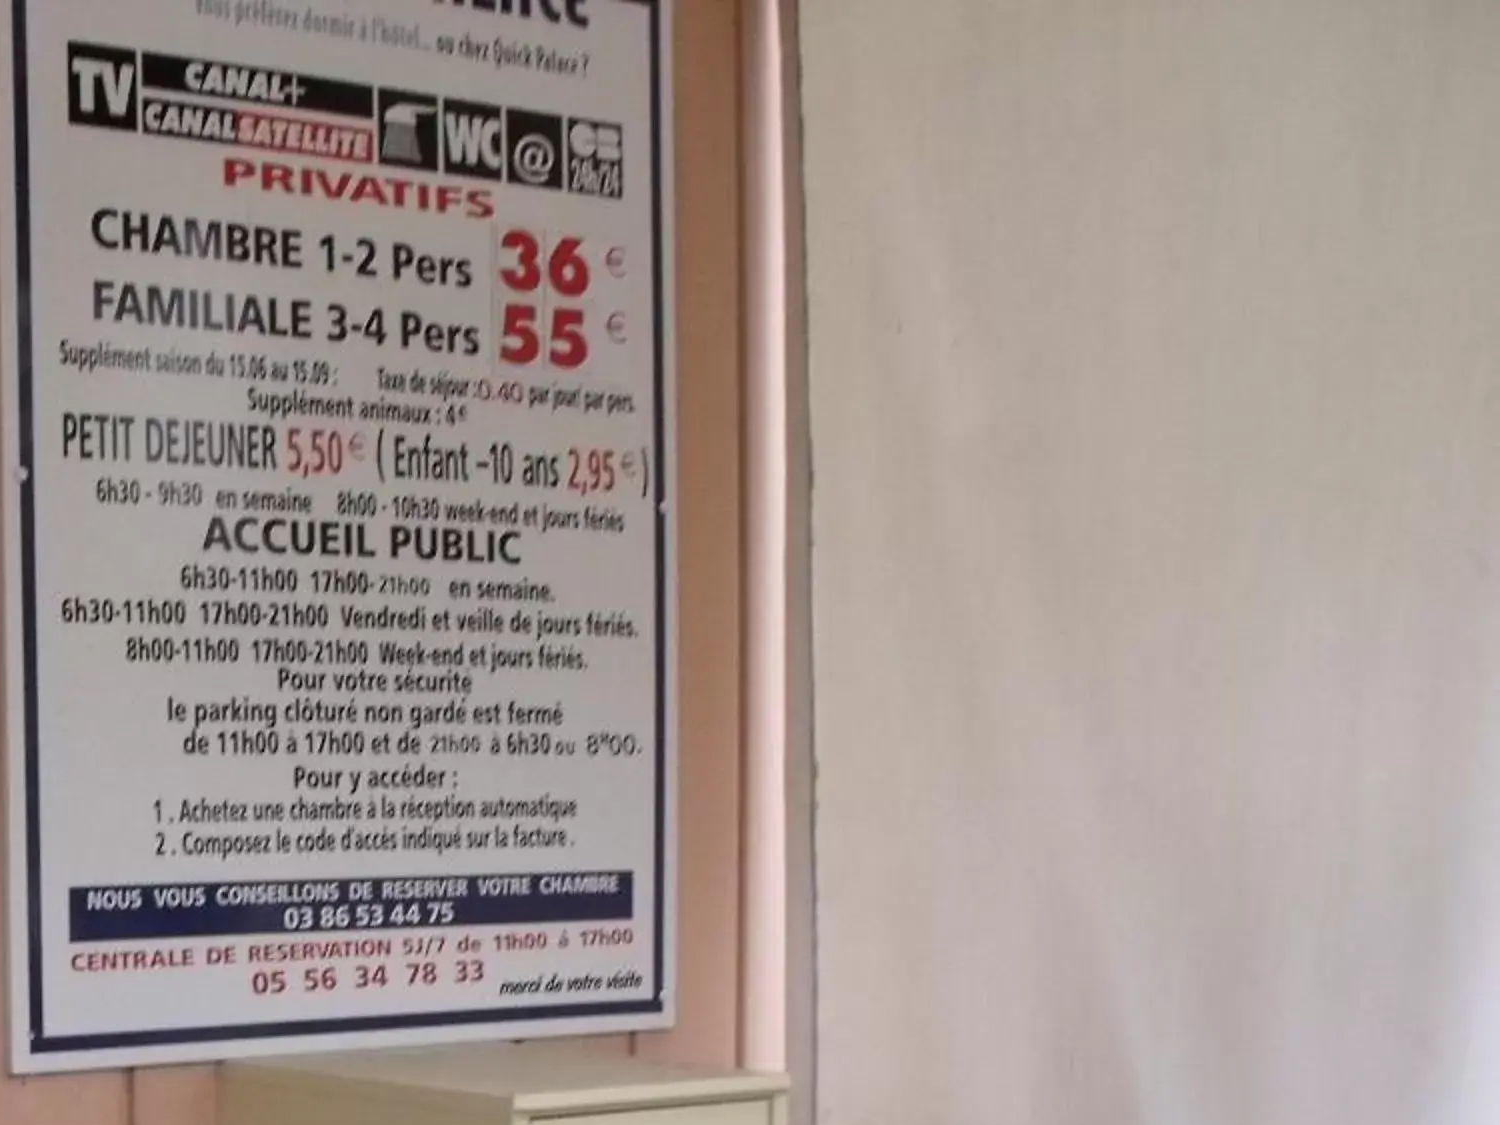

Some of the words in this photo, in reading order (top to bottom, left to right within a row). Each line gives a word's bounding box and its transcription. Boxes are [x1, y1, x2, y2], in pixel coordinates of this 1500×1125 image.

[436, 34, 455, 55] ou
[459, 30, 490, 63] chez
[493, 35, 531, 71] Quick
[534, 43, 578, 76] Palace
[71, 56, 135, 118] TV
[184, 61, 308, 106] CANAL+
[445, 112, 502, 171] WC
[223, 157, 495, 219] PRIVATIFS
[91, 208, 303, 269] CHAMBRE
[319, 233, 378, 279] 1-2
[392, 242, 473, 288] Pers
[499, 228, 591, 298] 36
[92, 279, 313, 340] FAMILIALE
[326, 302, 388, 347] 3-4
[401, 310, 480, 356] Pers
[499, 302, 589, 371] 55
[59, 338, 151, 374] Supplément
[155, 347, 202, 376] saison
[205, 351, 225, 377] du
[271, 360, 289, 383] au
[246, 387, 354, 419] Supplément
[359, 398, 431, 425] animaux
[377, 367, 406, 394] Taxe
[409, 370, 426, 395] de
[528, 384, 550, 408] par
[584, 391, 605, 415] par
[61, 411, 136, 464] PETIT
[145, 416, 279, 471] DEJEUNER
[393, 433, 470, 483] Enfant
[522, 451, 560, 488] ans
[96, 478, 141, 505] 6h30
[158, 480, 204, 508] 9h30
[215, 490, 238, 511] en
[242, 486, 313, 515] semaine
[336, 488, 377, 518] 8h00
[392, 494, 439, 522] 10h30
[445, 498, 519, 527] week-end
[522, 507, 538, 528] et
[541, 504, 579, 534] jours
[202, 516, 377, 559] ACCUEIL
[390, 524, 522, 566] PUBLIC
[180, 564, 298, 593] 6h30-11h00
[449, 580, 471, 600] en
[60, 598, 187, 626] 6h30-11h00
[198, 601, 329, 629] 17h00-21h00
[340, 605, 427, 632] Vendredi
[431, 609, 451, 632] et
[456, 606, 504, 635] veille
[509, 609, 532, 634] de
[535, 610, 581, 641] jours
[125, 636, 240, 664] 8h00-11h00
[250, 638, 369, 667] 17h00-21h00
[378, 640, 464, 668] Week-end
[468, 646, 487, 668] et
[489, 645, 534, 674] jours
[277, 667, 327, 693] Pour
[332, 671, 388, 693] votre
[166, 695, 188, 723] le
[194, 695, 278, 729] parking
[284, 697, 358, 724] clôturé
[364, 703, 404, 724] non
[409, 697, 467, 730] gardé
[472, 703, 502, 726] est
[507, 699, 564, 727] fermé
[183, 729, 210, 756] de
[217, 730, 279, 756] 11h00
[285, 730, 298, 756] à
[304, 730, 365, 756] 17h00
[371, 731, 391, 756] et
[396, 730, 421, 756] de
[429, 734, 482, 756] 21h00
[490, 734, 501, 756] à
[506, 731, 551, 757] 6h30
[293, 765, 343, 790] Pour
[348, 769, 362, 795] y
[367, 762, 447, 790] accéder
[179, 797, 248, 824] Achetez
[252, 802, 285, 823] une
[289, 796, 362, 822] chambre
[366, 798, 377, 821] à
[380, 795, 396, 821] la
[400, 794, 476, 823] réception
[478, 792, 578, 823] automatique
[181, 830, 272, 862] Composez
[275, 826, 291, 854] le
[296, 826, 336, 853] code
[401, 825, 462, 856] indiqué
[465, 829, 491, 851] sur
[493, 825, 509, 851] la
[86, 888, 143, 912] NOUS
[152, 885, 206, 909] VOUS
[214, 881, 340, 906] CONSEILLONS
[348, 881, 374, 901] DE
[381, 878, 470, 900] RESERVER
[476, 876, 532, 898] VOTRE
[538, 873, 620, 896] CHAMBRE
[282, 906, 314, 931] 03
[318, 905, 350, 930] 86
[354, 903, 386, 927] 53
[389, 902, 422, 926] 44
[425, 900, 456, 924] 75
[70, 947, 196, 974] CENTRALE
[205, 945, 238, 967] DE
[247, 938, 392, 964] RESERVATION
[456, 934, 483, 954] de
[493, 930, 548, 952] 11h00
[578, 927, 634, 948] 17h00
[251, 970, 288, 996] 05
[303, 966, 338, 993] 56
[354, 964, 389, 990] 34
[404, 961, 438, 987] 78
[454, 959, 486, 984] 33
[498, 976, 543, 998] merci
[544, 973, 563, 994] de
[566, 973, 603, 993] votre
[605, 968, 644, 991] visite
